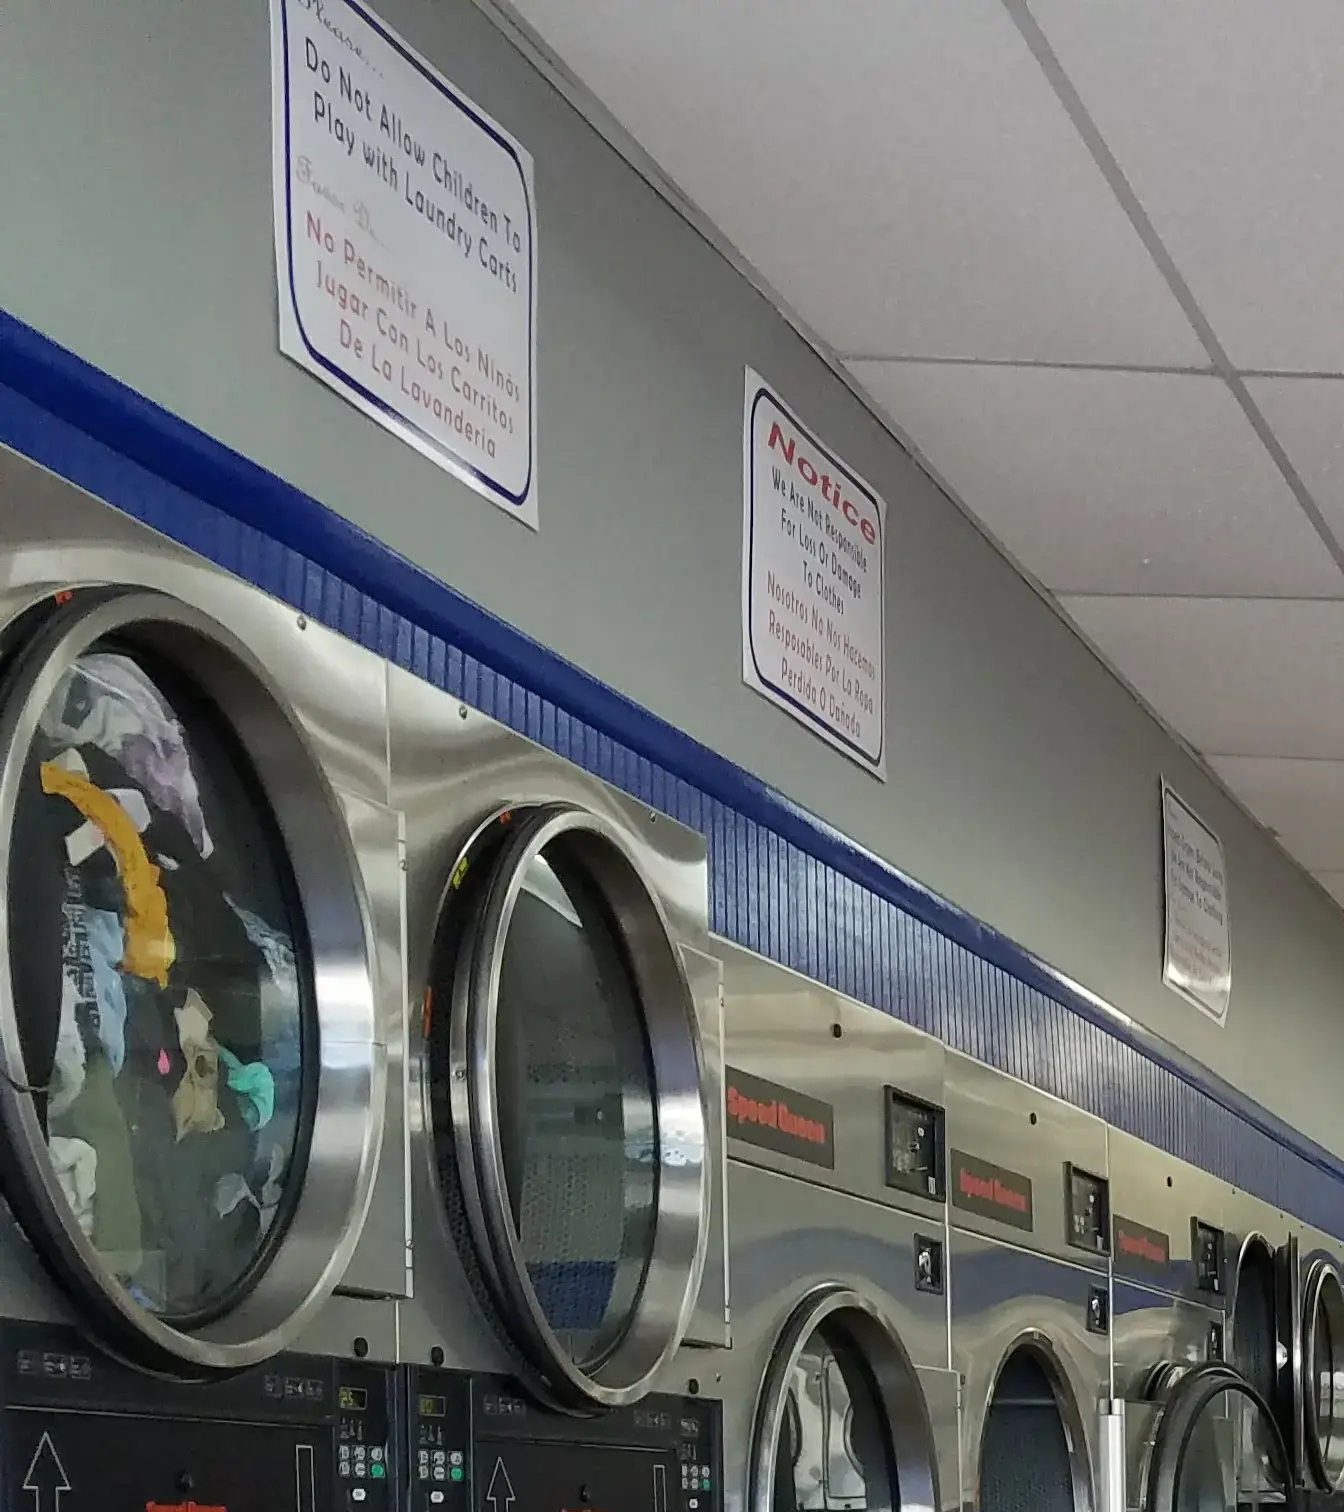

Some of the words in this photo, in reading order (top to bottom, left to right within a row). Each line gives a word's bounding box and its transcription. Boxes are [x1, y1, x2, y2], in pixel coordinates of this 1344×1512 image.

[305, 36, 330, 84] Do
[339, 66, 371, 121] Not
[380, 104, 425, 167] Allow
[432, 152, 498, 234] Children
[503, 214, 521, 253] To
[314, 91, 355, 156] Play
[363, 142, 398, 191] with
[405, 172, 472, 257] Laundry
[479, 237, 517, 292] Carts
[306, 210, 334, 253] No
[343, 238, 416, 319] Permitir
[425, 308, 437, 338] A
[444, 321, 470, 363] Los
[316, 260, 368, 318] Jugar
[376, 308, 408, 352] Con
[417, 340, 444, 380] Los
[451, 366, 514, 434] Carritos
[340, 319, 363, 360] De
[372, 344, 392, 382] La
[400, 366, 496, 458] Lavanderia
[768, 421, 876, 545] Notice
[772, 465, 786, 496] We
[790, 483, 805, 513] Are
[808, 498, 823, 531] Not
[825, 514, 867, 573] Responsible
[767, 570, 808, 624] Nosotros
[811, 604, 823, 635] No
[826, 618, 841, 651] Nos
[781, 508, 796, 536] For
[799, 523, 816, 557] Loss
[819, 542, 829, 569] Or
[831, 552, 861, 599] Damage
[803, 560, 813, 589] To
[815, 572, 844, 615] Clothes
[781, 657, 817, 704] Perdida
[819, 686, 827, 712] O
[825, 654, 840, 684] Por
[842, 669, 853, 699] La
